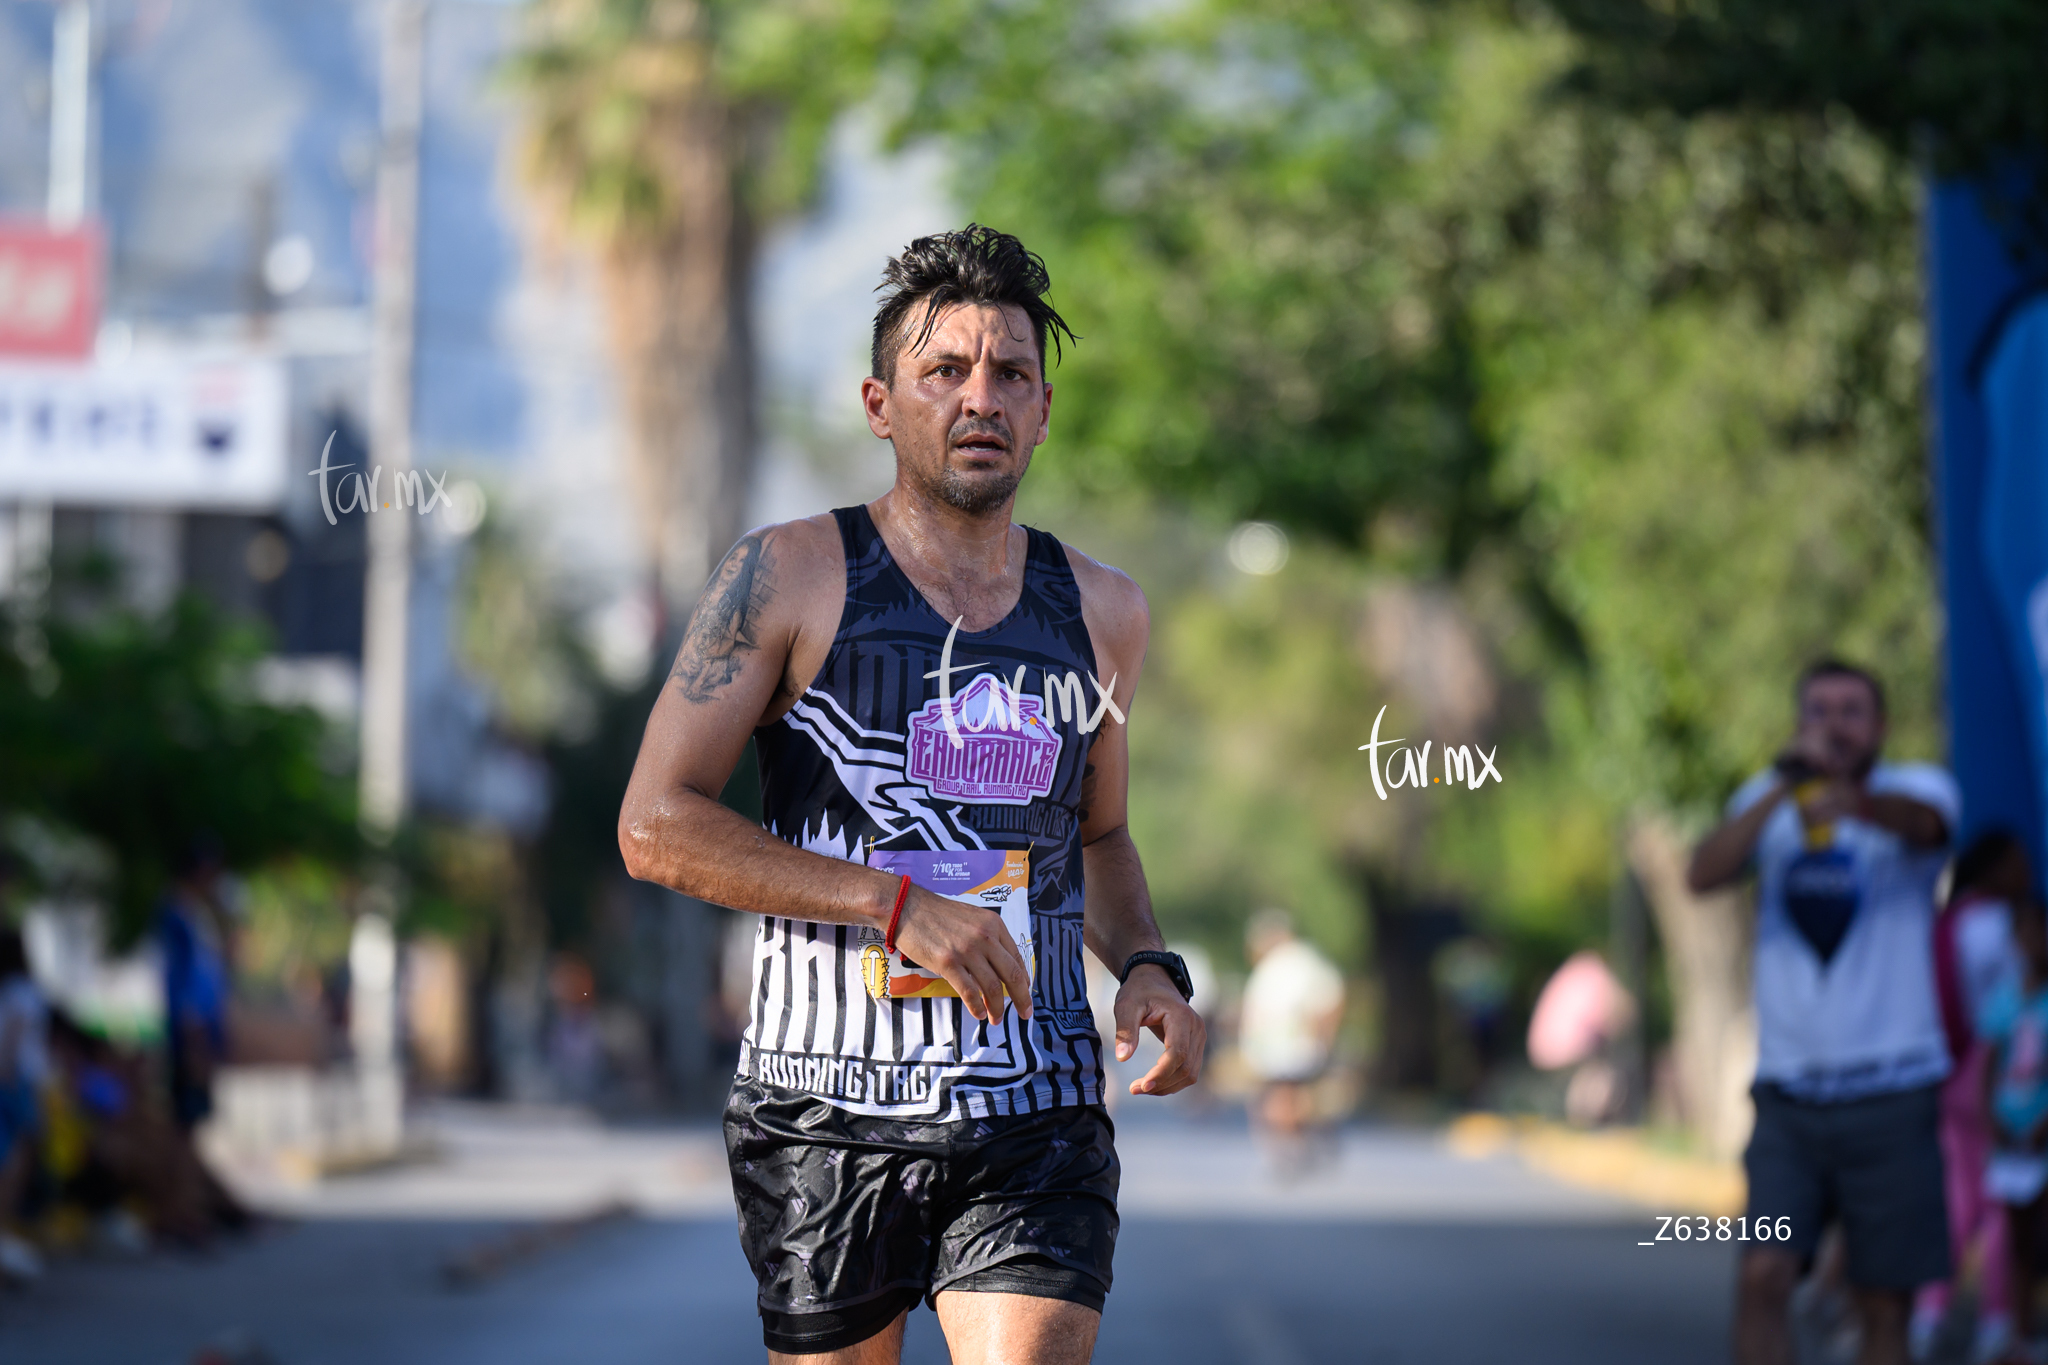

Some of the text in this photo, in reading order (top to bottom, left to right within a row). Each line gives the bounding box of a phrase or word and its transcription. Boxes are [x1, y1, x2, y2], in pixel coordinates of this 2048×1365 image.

[915, 727, 1056, 788] ENDURANCE
[937, 779, 960, 793] GROUP
[962, 783, 981, 795] TRAIL
[984, 784, 1012, 796] RUNNING
[758, 1052, 863, 1100] RUNNING
